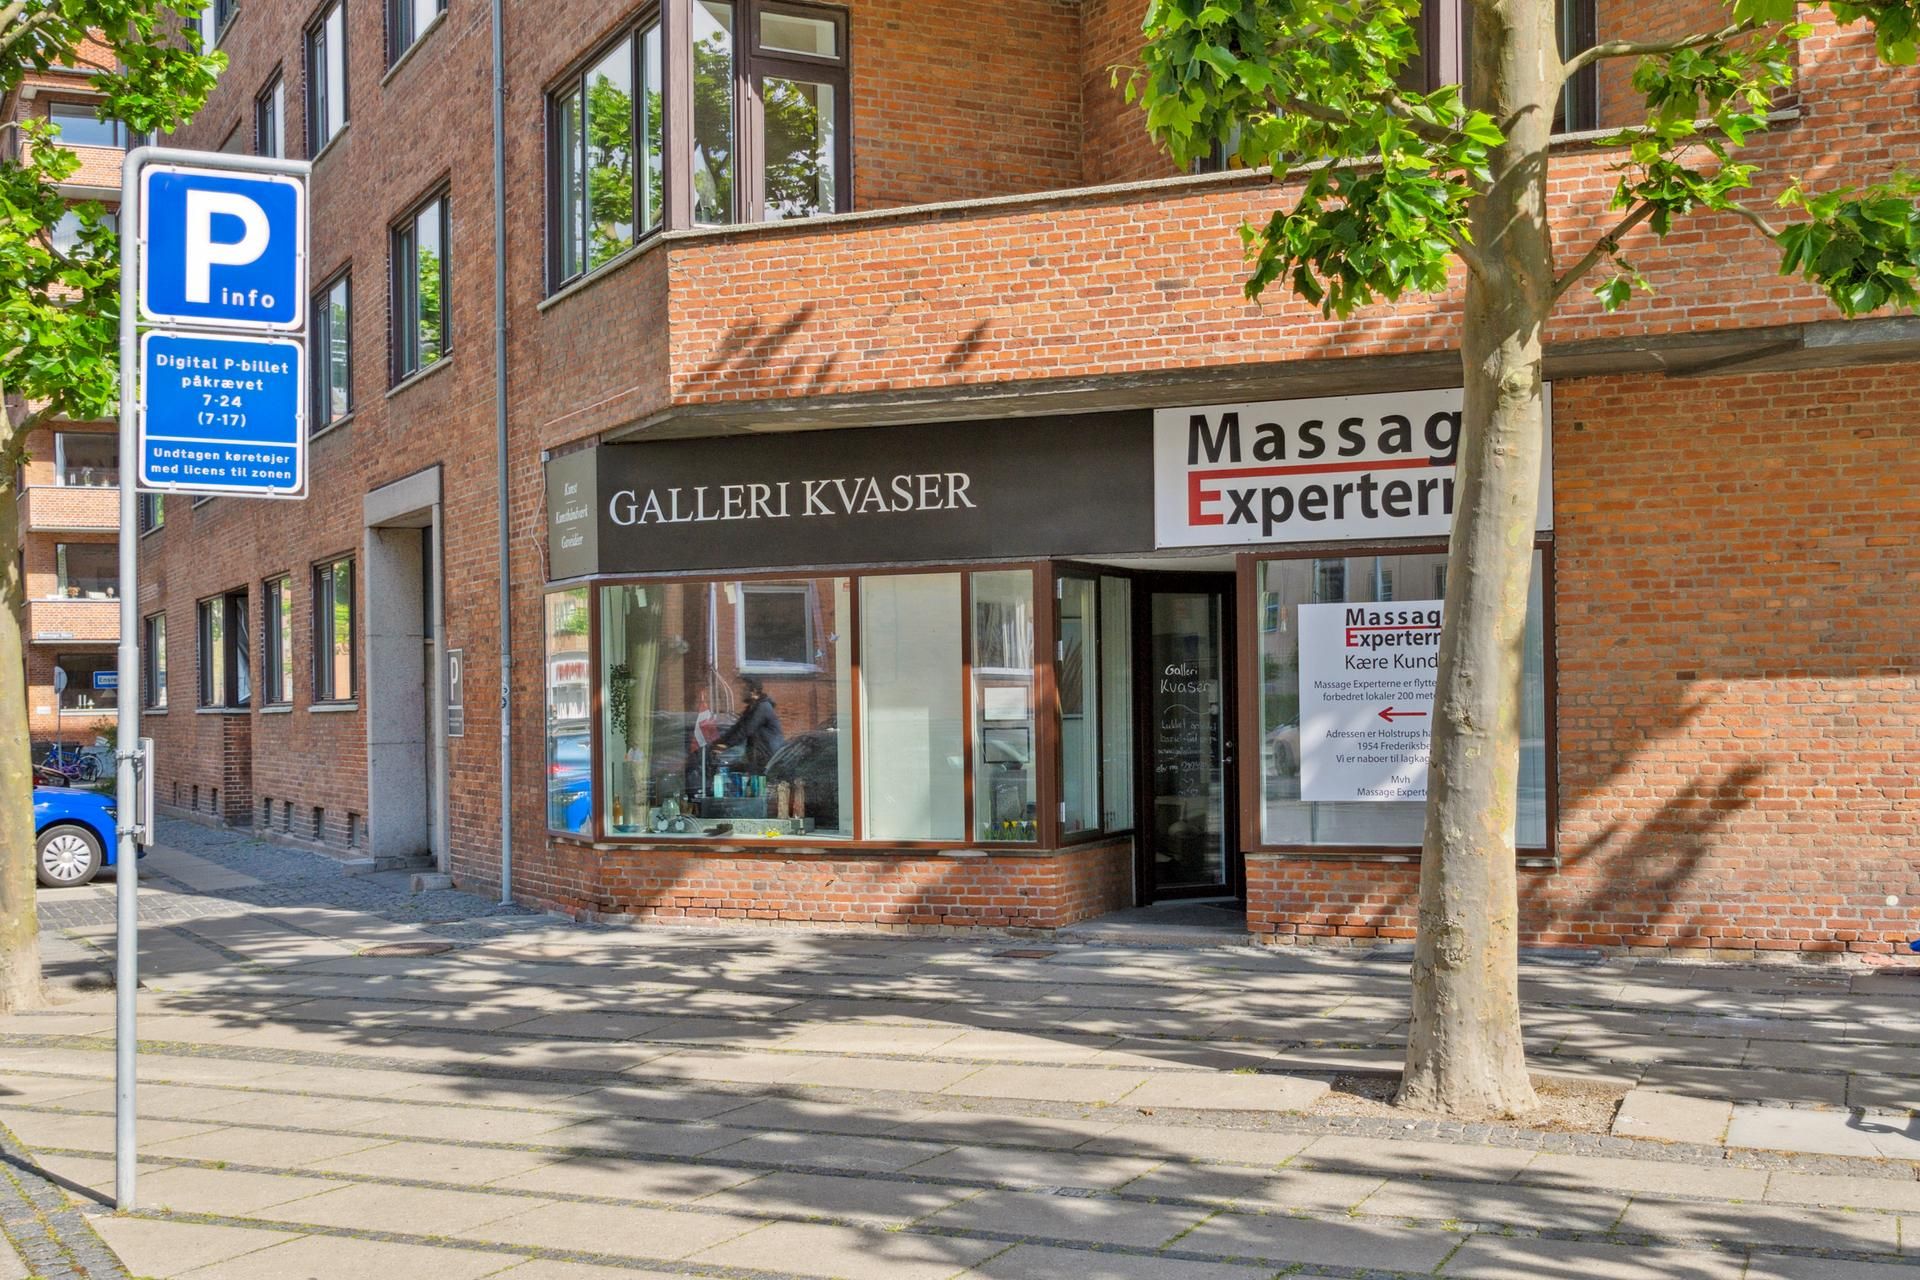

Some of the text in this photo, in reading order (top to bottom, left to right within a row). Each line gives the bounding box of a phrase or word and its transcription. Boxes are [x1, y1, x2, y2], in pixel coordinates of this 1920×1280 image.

[186, 189, 270, 304] P
[222, 287, 275, 309] info
[156, 354, 288, 374] Digital P-billet
[181, 375, 263, 391] påkrævet
[203, 394, 242, 407] 7-24
[198, 412, 246, 427] (7-17)
[1188, 410, 1463, 467] Massag
[153, 448, 290, 464] Undtagen køretøjer
[151, 464, 291, 479] med licens til zonen
[608, 472, 977, 526] GALLERI KVASER
[1345, 608, 1441, 629] Massag
[1345, 652, 1439, 670] Kære Kund
[1165, 663, 1198, 676] Galleri
[450, 657, 459, 701] P
[1160, 679, 1211, 693] Kvaser
[1314, 681, 1351, 690] Massage
[1353, 680, 1401, 690] Experterne
[1414, 678, 1436, 689] flytte
[1323, 692, 1364, 701] forbedret
[1365, 692, 1395, 701] lokaler
[1397, 692, 1414, 700] 200
[1326, 730, 1365, 738] Adressen
[1378, 729, 1420, 740] Holstrups
[1357, 742, 1378, 750] 1954
[1336, 755, 1344, 763] Vi
[1357, 754, 1389, 763] naboer
[1390, 754, 1399, 763] til
[1391, 775, 1411, 784] Mvh
[1357, 788, 1395, 798] Massage
